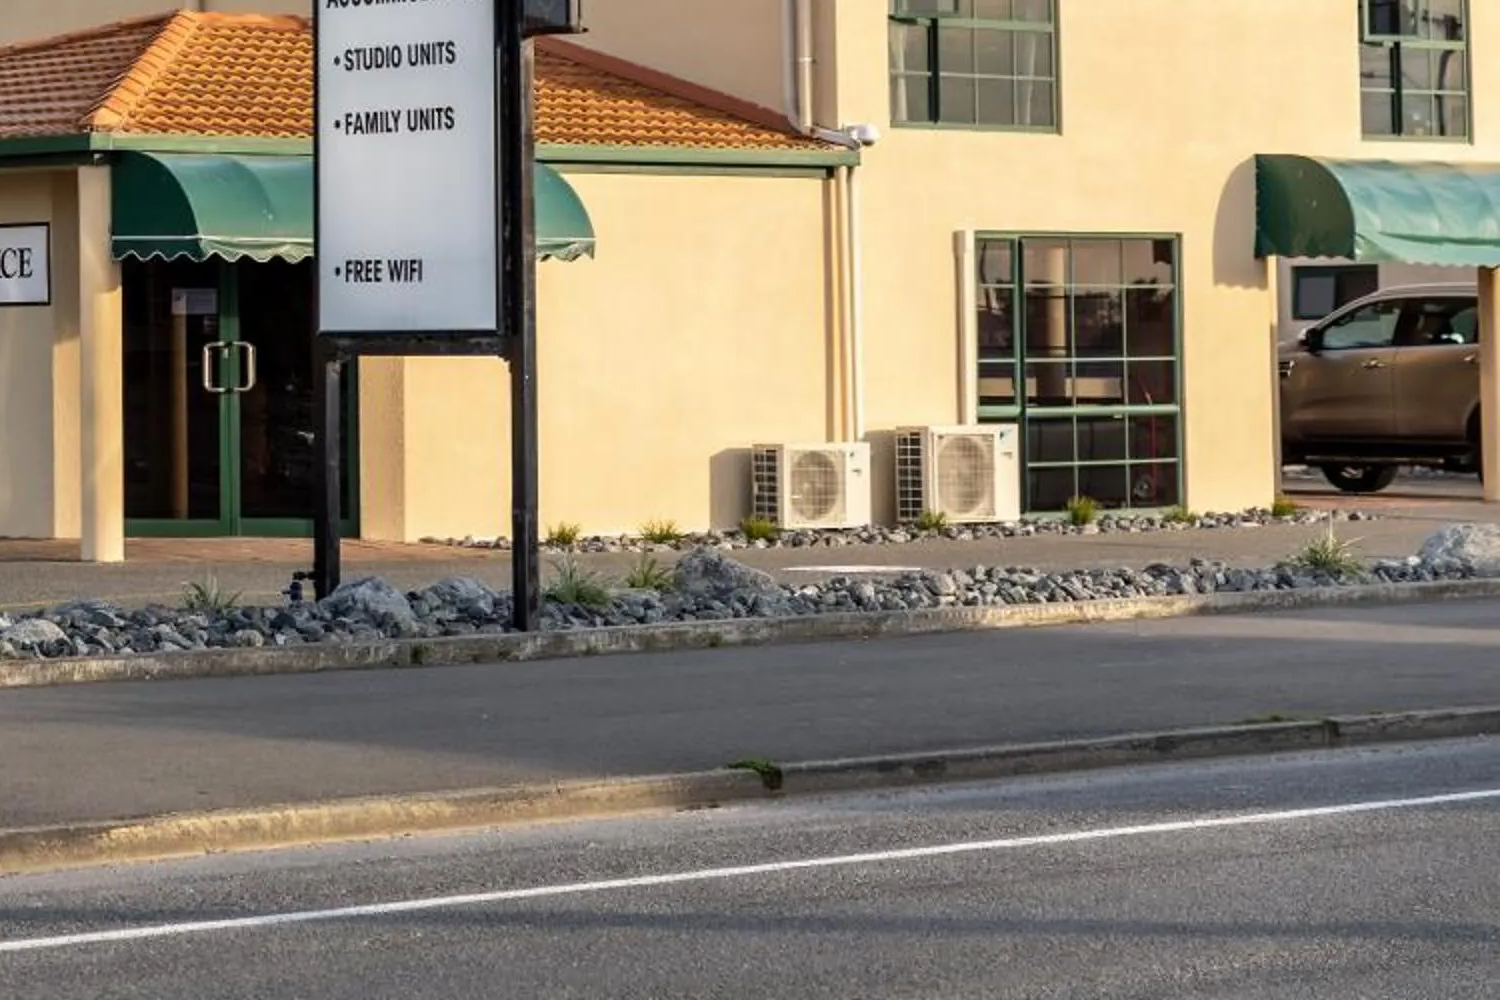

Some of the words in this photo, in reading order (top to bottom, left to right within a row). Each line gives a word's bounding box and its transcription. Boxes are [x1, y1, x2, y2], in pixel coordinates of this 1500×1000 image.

[344, 44, 402, 71] STUDIO
[407, 41, 457, 66] UNITS
[344, 109, 402, 135] FAMILY
[407, 107, 456, 132] UNITS
[344, 259, 383, 283] FREE
[388, 258, 424, 283] WIFI
